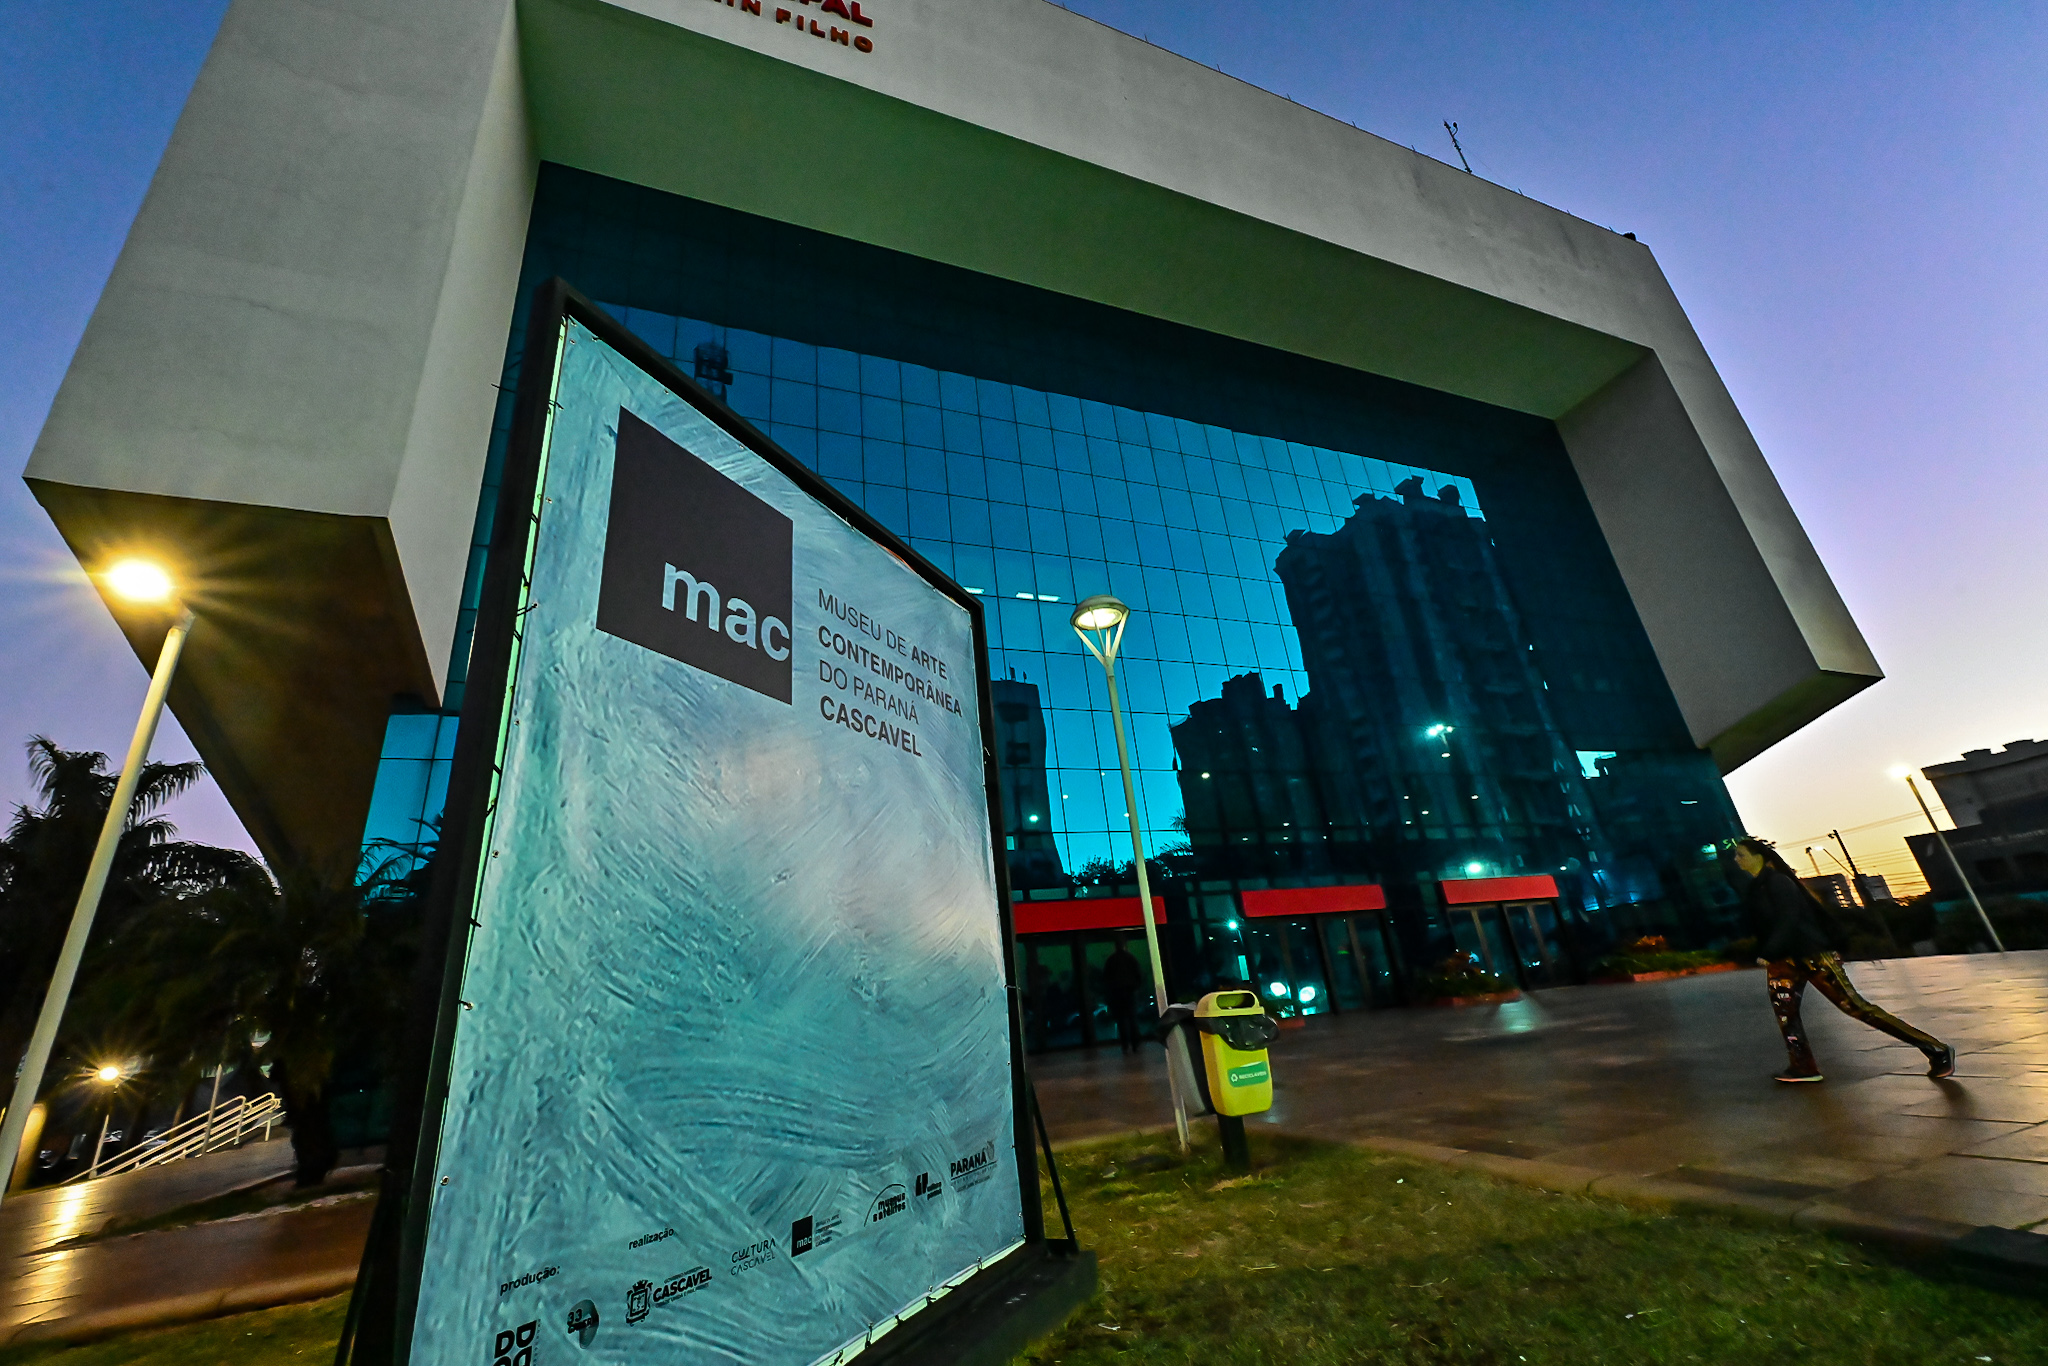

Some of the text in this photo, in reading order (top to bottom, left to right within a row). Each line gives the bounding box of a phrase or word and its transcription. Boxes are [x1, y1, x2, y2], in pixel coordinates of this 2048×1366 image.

[775, 7, 873, 54] FILHO
[662, 561, 790, 662] mac
[818, 588, 947, 680] MUSEU DE ARTE
[818, 625, 962, 718] CONTEMPORÂNEA
[819, 659, 919, 725] DO PARANÁ
[820, 695, 922, 757] CASCAVEL
[628, 1227, 674, 1250] realização
[731, 1237, 776, 1264] CULTURA
[796, 1235, 812, 1249] mac
[500, 1265, 560, 1296] produção:
[730, 1249, 776, 1276] CASCAVEL
[652, 1268, 713, 1303] CASCAVEL
